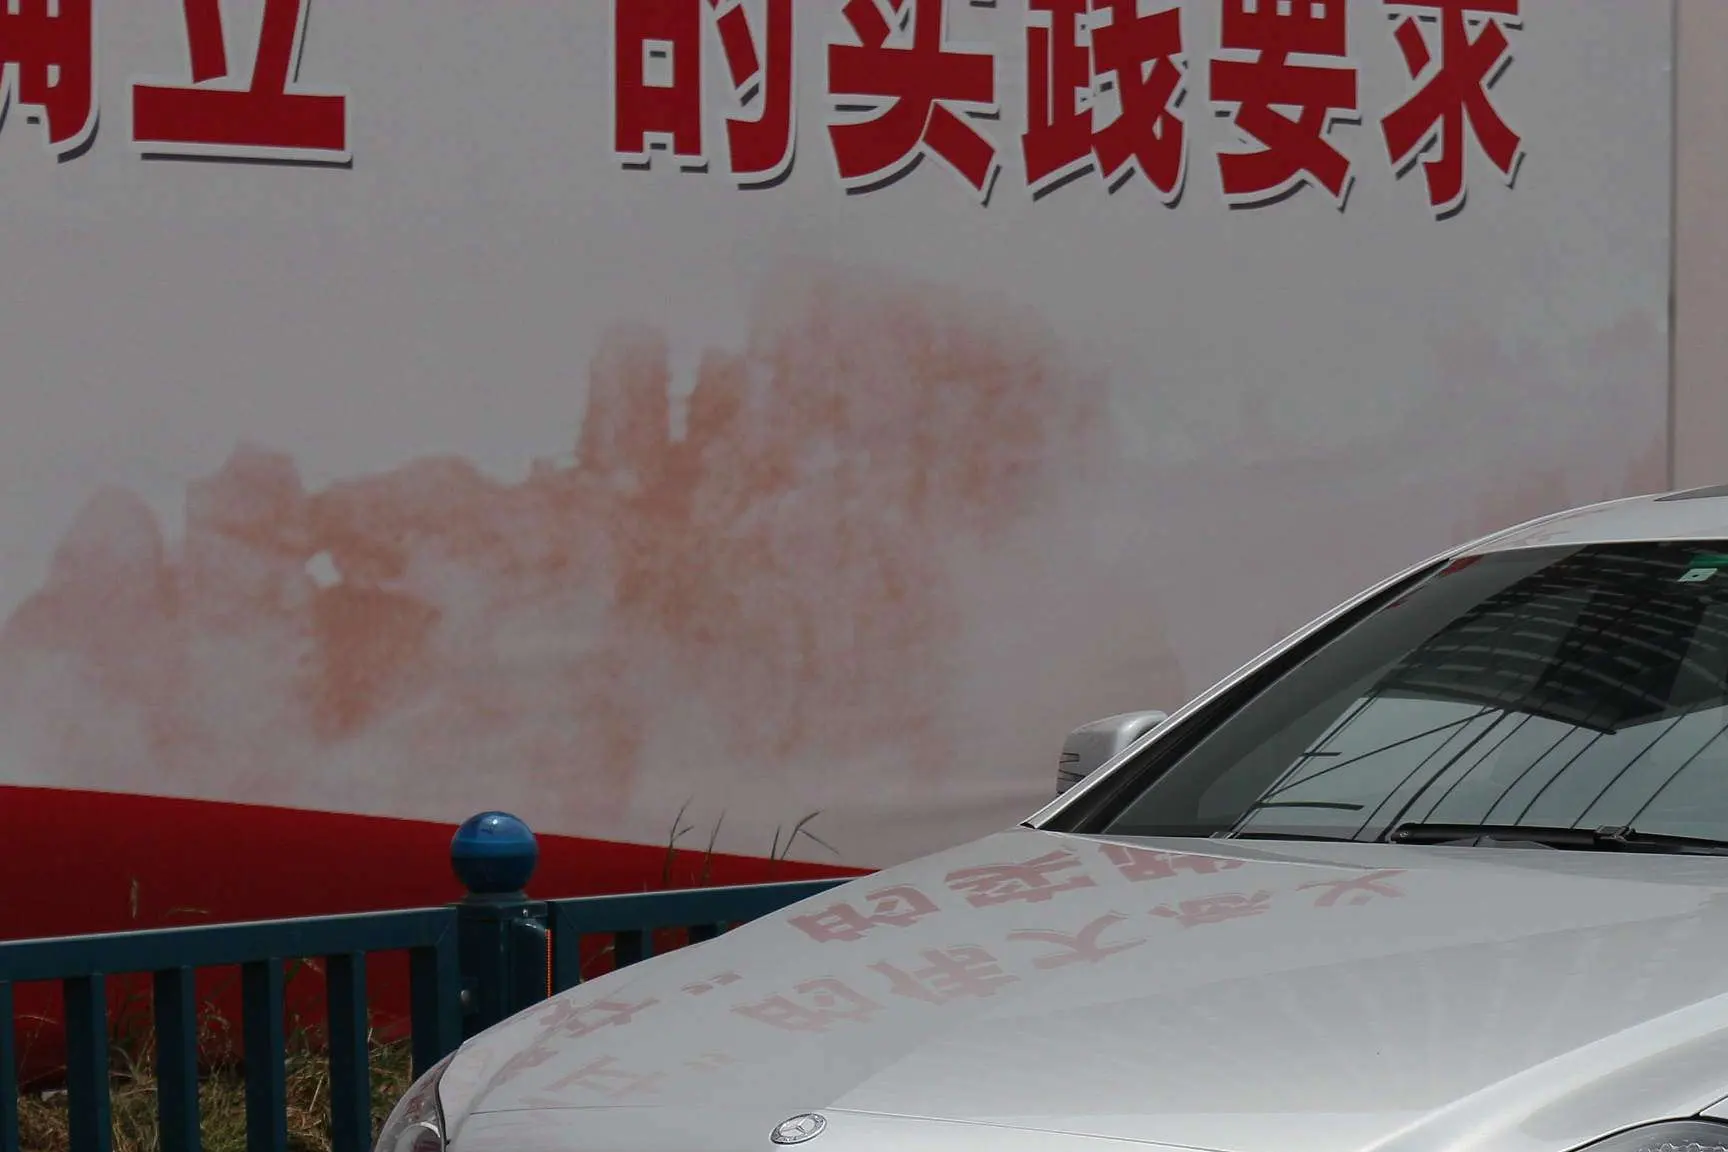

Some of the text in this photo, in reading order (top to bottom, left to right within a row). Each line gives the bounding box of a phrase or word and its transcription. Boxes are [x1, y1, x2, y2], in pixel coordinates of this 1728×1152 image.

[614, 0, 1524, 214] 的实践要求
